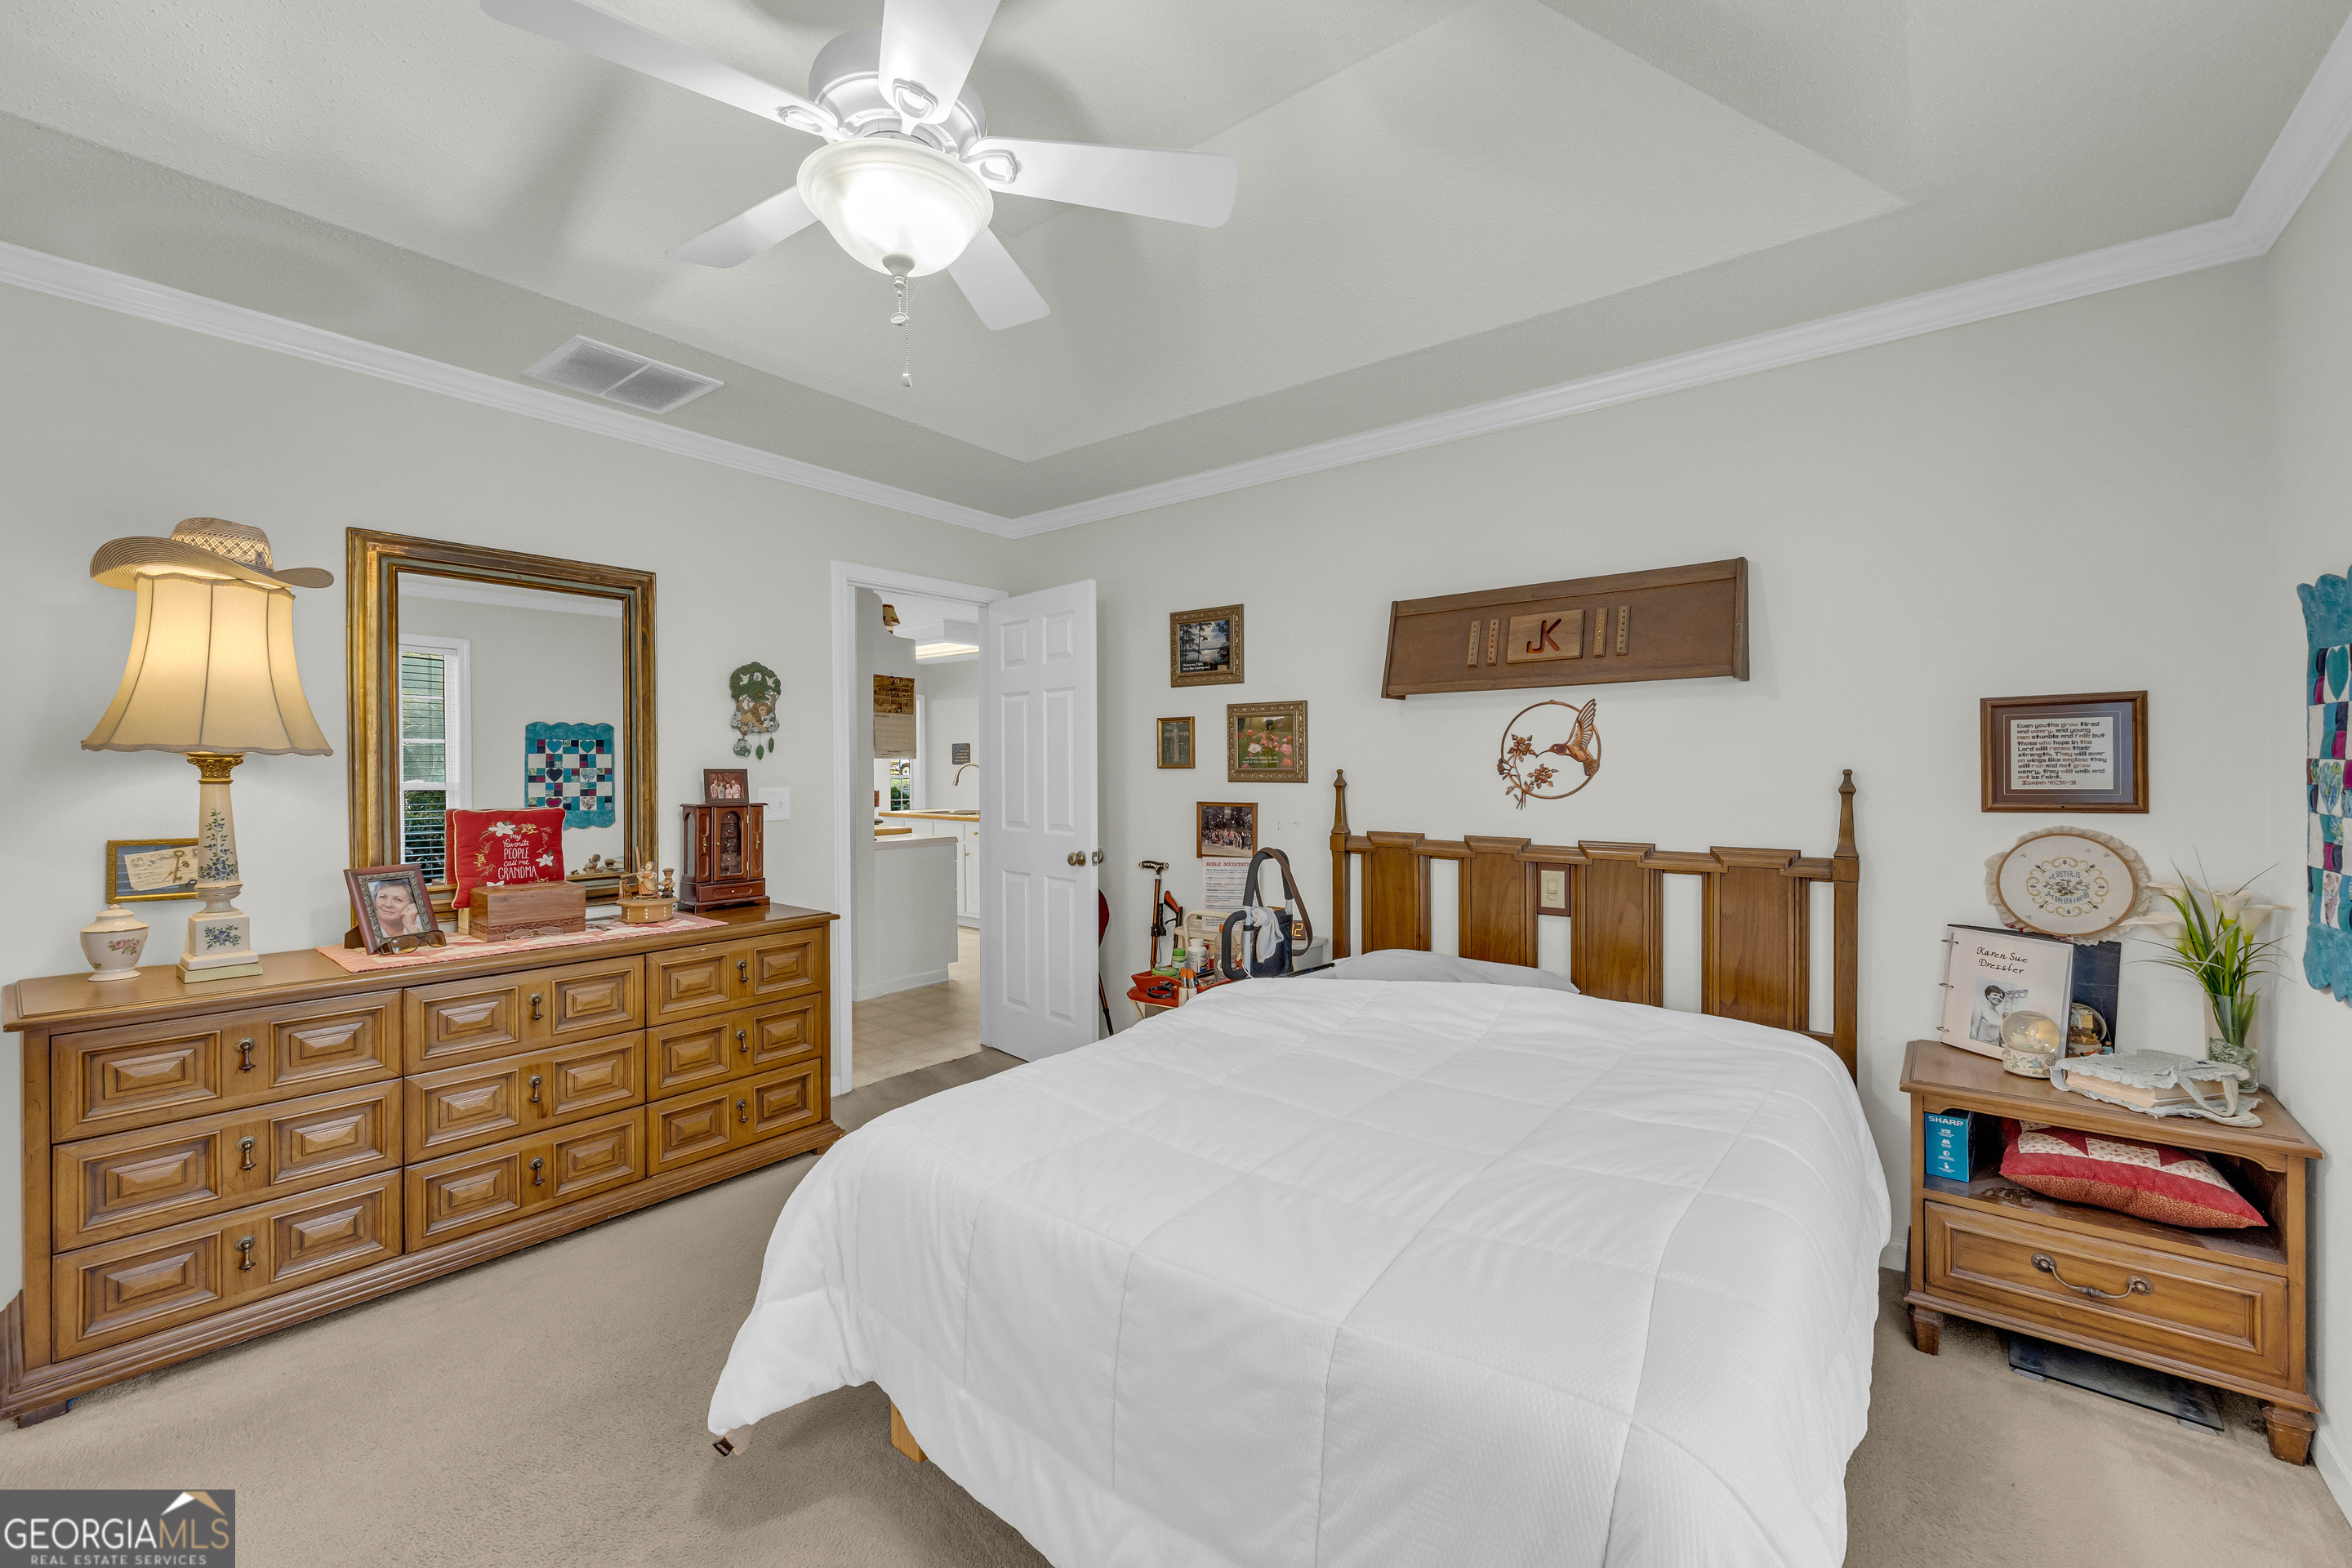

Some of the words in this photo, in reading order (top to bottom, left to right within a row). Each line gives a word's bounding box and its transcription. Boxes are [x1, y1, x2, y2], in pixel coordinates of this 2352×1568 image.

[1526, 618, 1561, 653] JK
[503, 838, 529, 847] favorite
[504, 847, 530, 860] PEOPLE
[498, 866, 537, 880] GRANDMA
[1976, 947, 2007, 959] Karen
[2009, 952, 2028, 963] Sue
[1978, 959, 2024, 974] Dressler
[1928, 1116, 1964, 1126] SHARP
